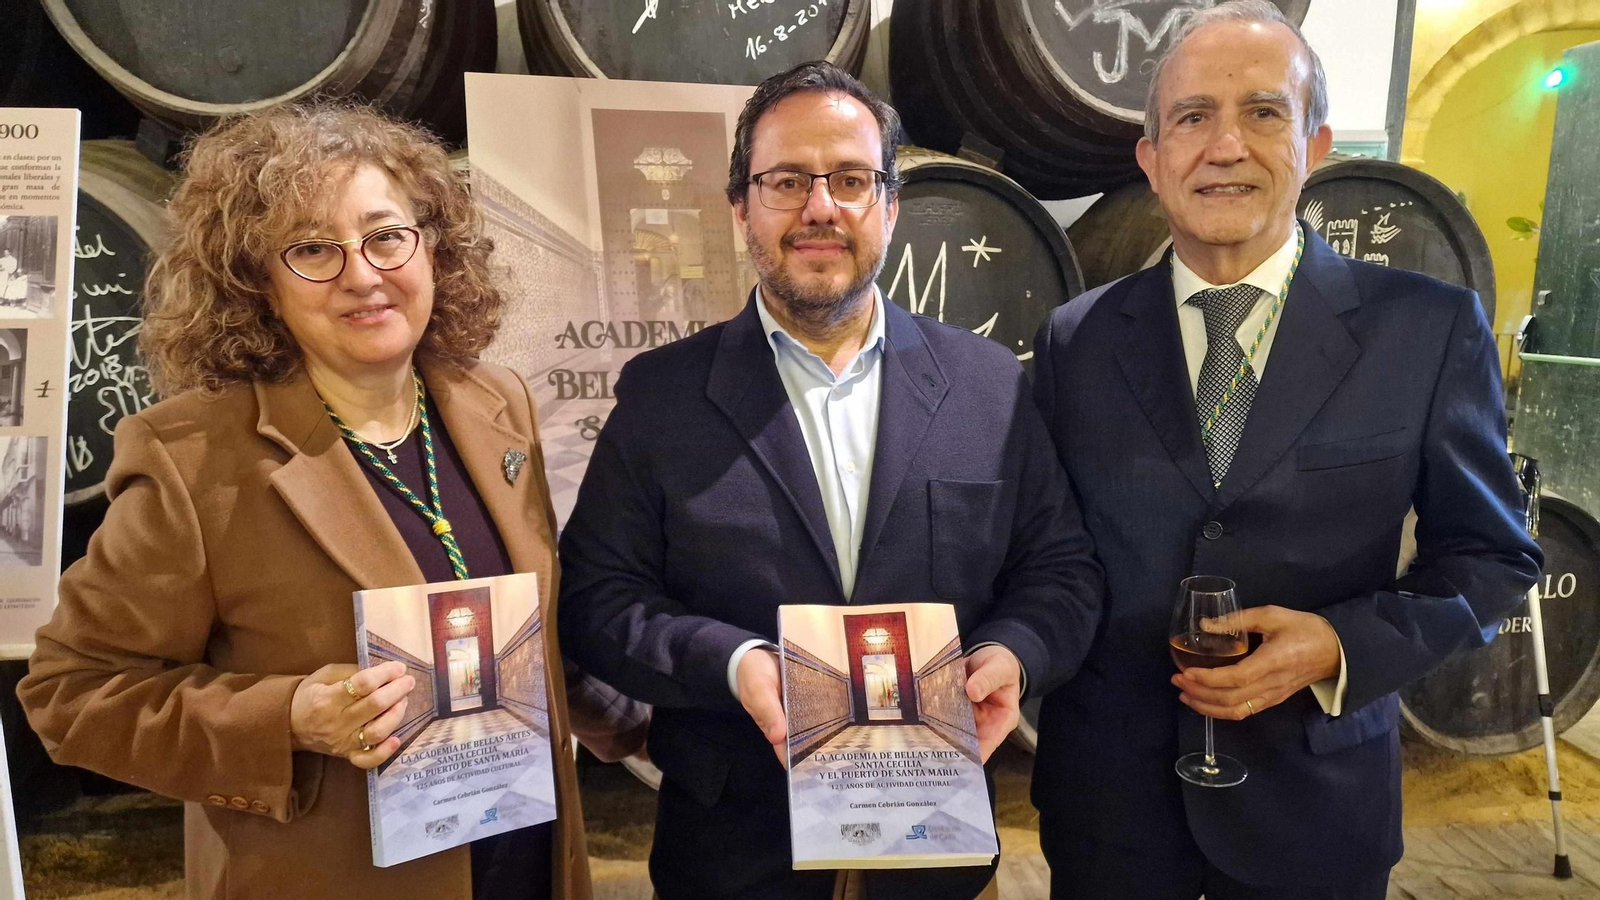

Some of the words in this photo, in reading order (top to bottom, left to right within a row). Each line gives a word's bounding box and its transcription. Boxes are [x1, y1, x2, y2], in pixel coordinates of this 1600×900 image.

[37, 155, 50, 163] por
[11, 163, 52, 171] conforman
[23, 172, 54, 180] liberales
[2, 184, 19, 192] gran
[401, 755, 412, 765] LA
[413, 744, 459, 762] ACADEMIA
[460, 741, 472, 751] DE
[473, 735, 504, 748] BELLAS
[505, 729, 531, 741] ARTES
[437, 753, 465, 766] SANTA
[466, 745, 498, 759] CECILIA
[813, 754, 826, 762] LA
[828, 752, 878, 761] ACADEMIA
[880, 751, 893, 760] DE
[894, 751, 929, 759] BELLAS
[930, 750, 960, 759] ARTES
[405, 773, 411, 782] Y
[413, 771, 424, 781] EL
[425, 763, 459, 778] PUERTO
[461, 759, 472, 769] DE
[473, 753, 501, 766] SANTA
[854, 761, 885, 769] SANTA
[886, 760, 922, 769] CECILIA
[416, 782, 428, 790] 125
[446, 775, 456, 784] DE
[456, 767, 490, 780] ACTIVIDAD
[490, 760, 521, 773] CULTURAL
[819, 772, 826, 780] Y
[827, 772, 840, 780] EL
[841, 770, 879, 779] PUERTO
[881, 769, 894, 778] DE
[895, 769, 926, 777] SANTA
[433, 796, 456, 806] Carmen
